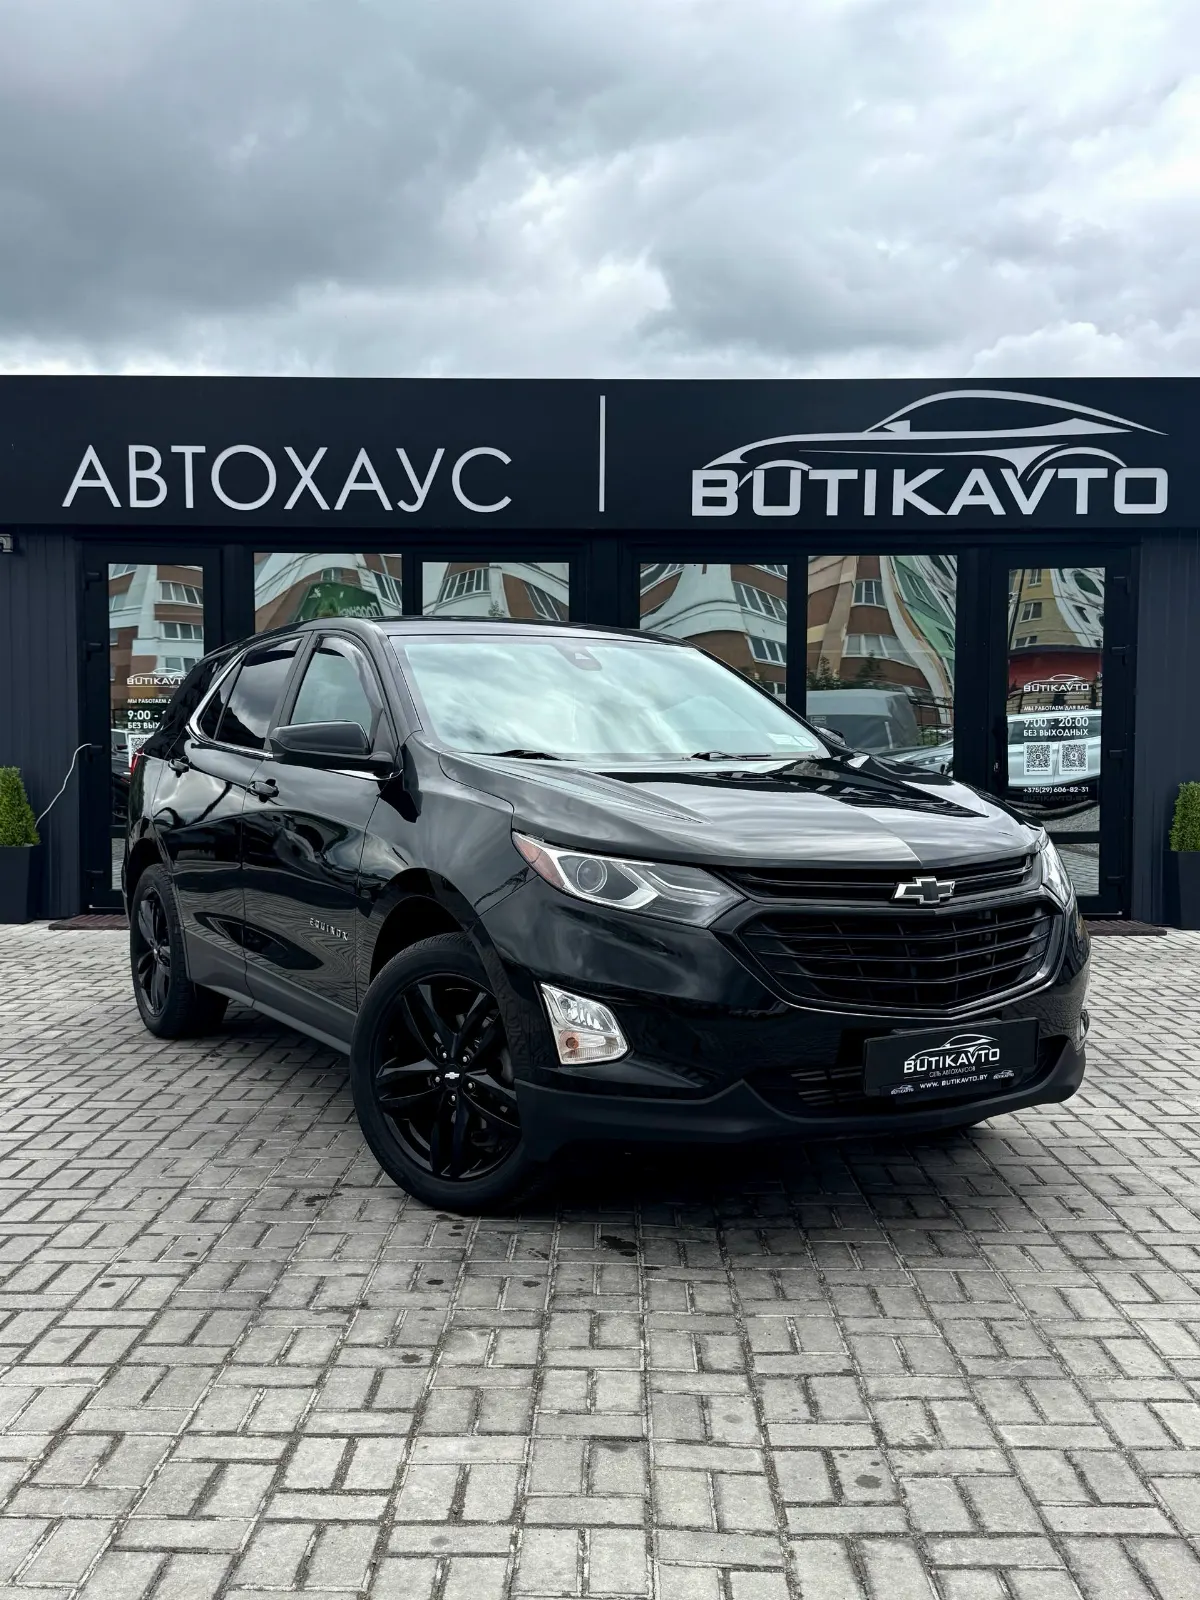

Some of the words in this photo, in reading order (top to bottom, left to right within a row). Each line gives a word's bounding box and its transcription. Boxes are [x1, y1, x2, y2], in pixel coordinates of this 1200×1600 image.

[62, 444, 512, 512] АВТОХАУС
[691, 467, 1169, 516] BUTIKAVTO
[127, 710, 151, 720] 9:00
[1024, 718, 1047, 728] 9:00
[1058, 717, 1089, 727] 20:00
[1023, 786, 1053, 794] +375(29)
[309, 917, 349, 941] EQUINOX
[903, 1048, 1000, 1074] BUTIKAVTO
